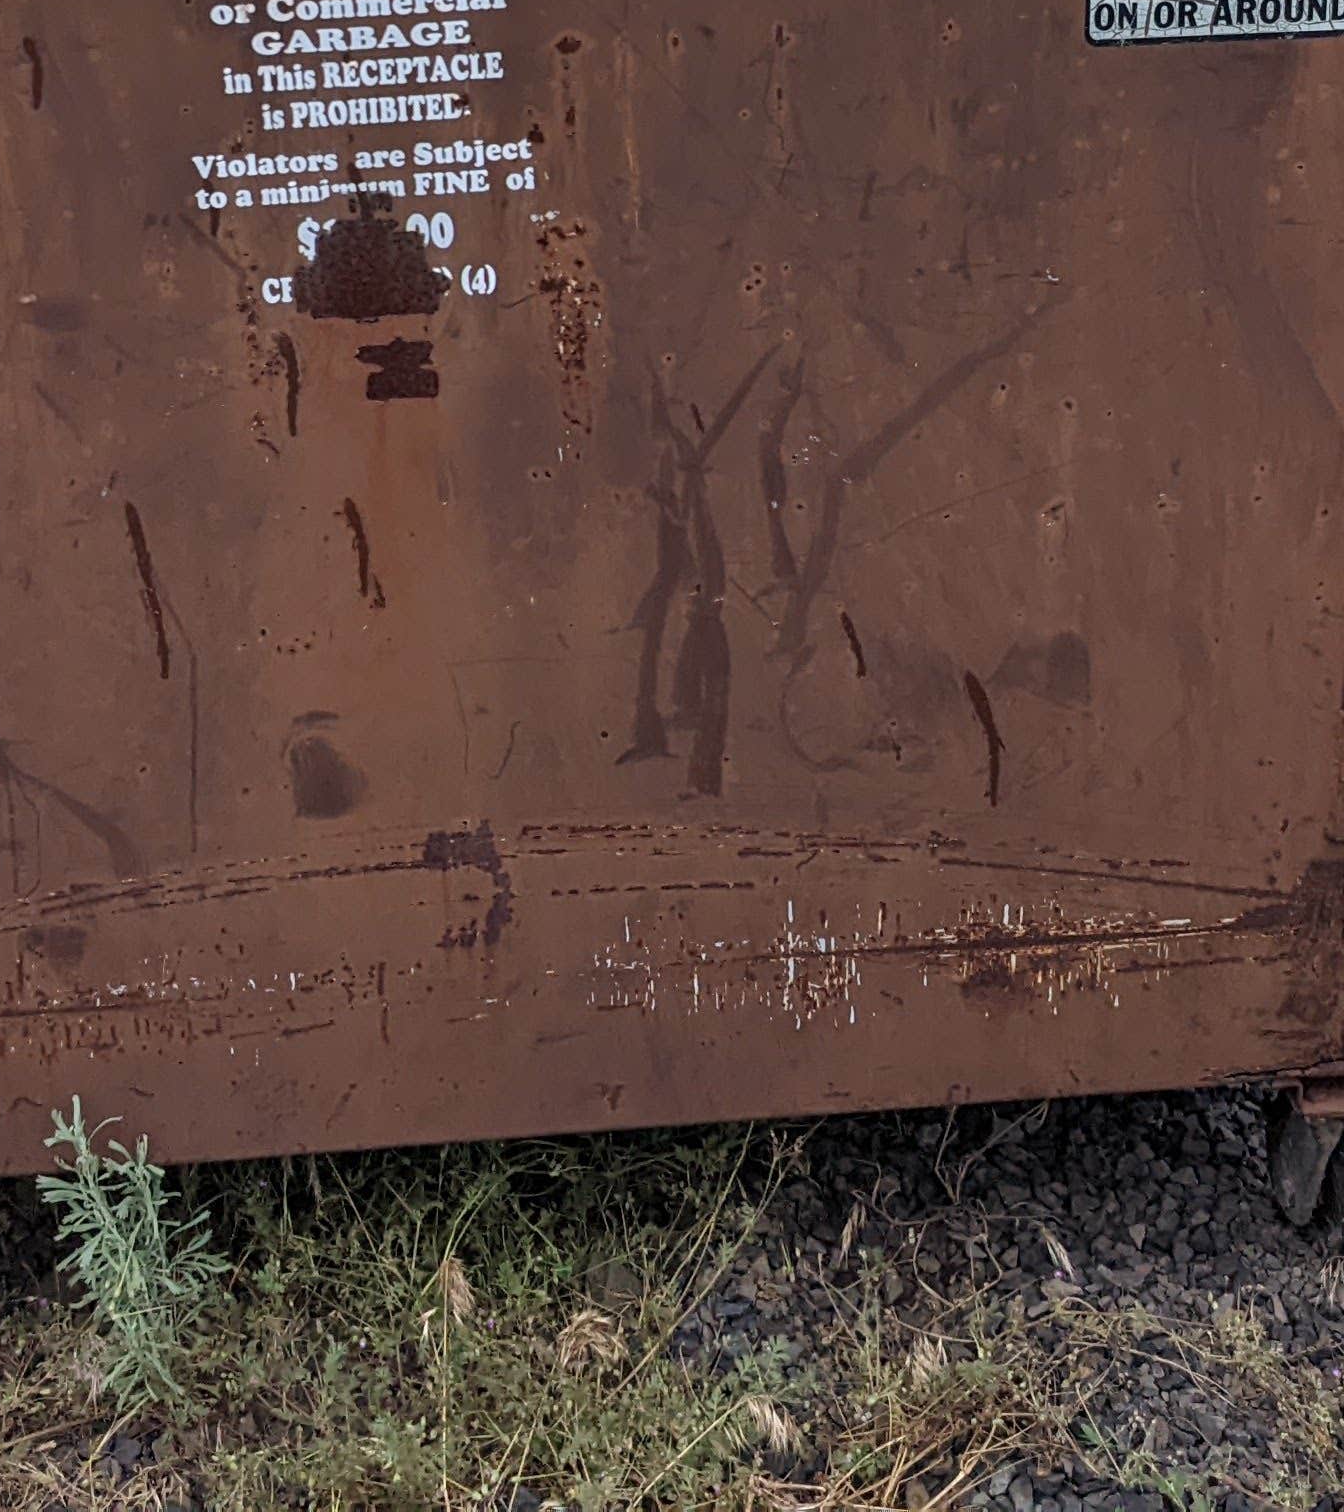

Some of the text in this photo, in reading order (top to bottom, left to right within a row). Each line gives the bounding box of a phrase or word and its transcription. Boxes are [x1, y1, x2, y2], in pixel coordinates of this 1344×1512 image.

[209, 2, 256, 26] or
[1093, 1, 1138, 31] ON
[1155, 0, 1198, 28] OR
[250, 19, 473, 56] GARBAGE
[222, 51, 505, 95] in This RECEPTACLE
[261, 103, 286, 130] is
[191, 138, 534, 180] Violators are Subject
[195, 187, 228, 210] to
[235, 188, 254, 208] a
[413, 168, 491, 196] FINE
[505, 167, 536, 191] of
